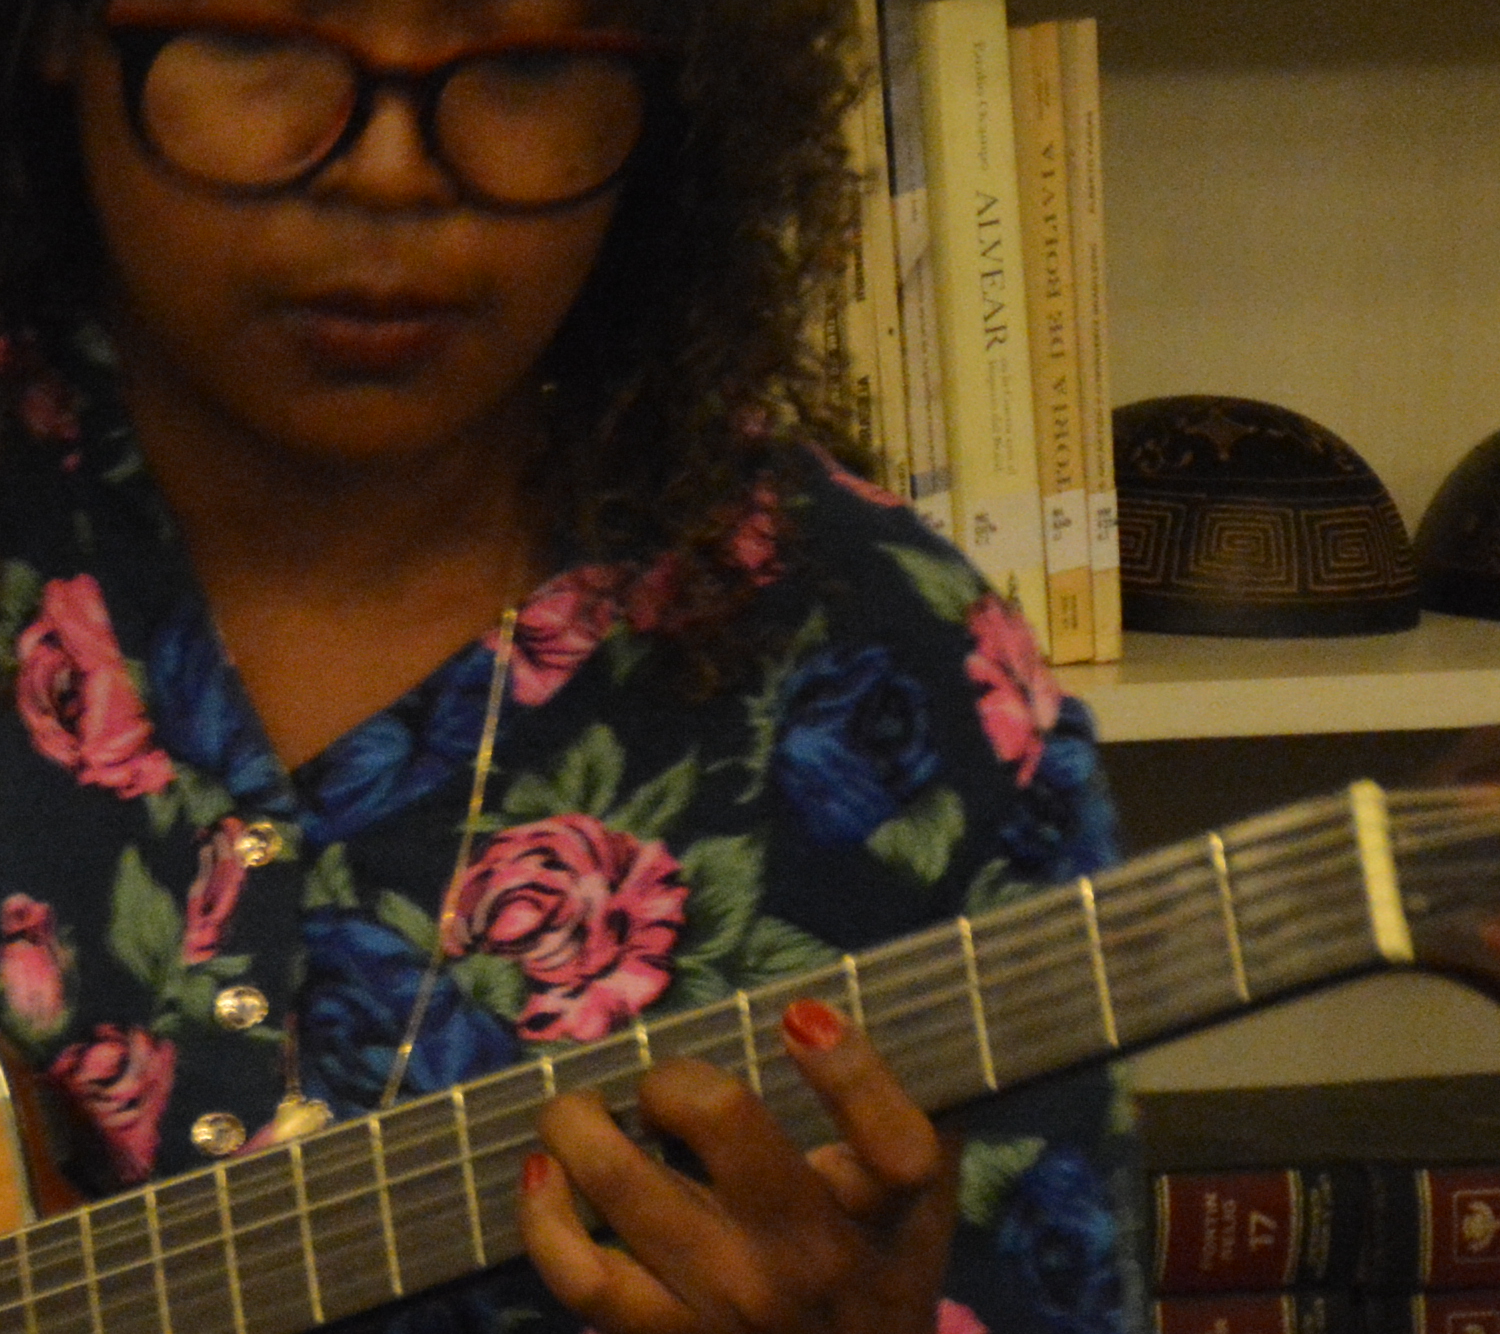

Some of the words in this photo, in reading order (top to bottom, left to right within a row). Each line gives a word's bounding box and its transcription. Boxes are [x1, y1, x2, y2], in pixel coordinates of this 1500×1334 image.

[974, 189, 1009, 352] ALVEAR
[1041, 142, 1061, 300] BOLIVIA
[1047, 311, 1065, 359] DE
[1249, 1210, 1278, 1250] 17
